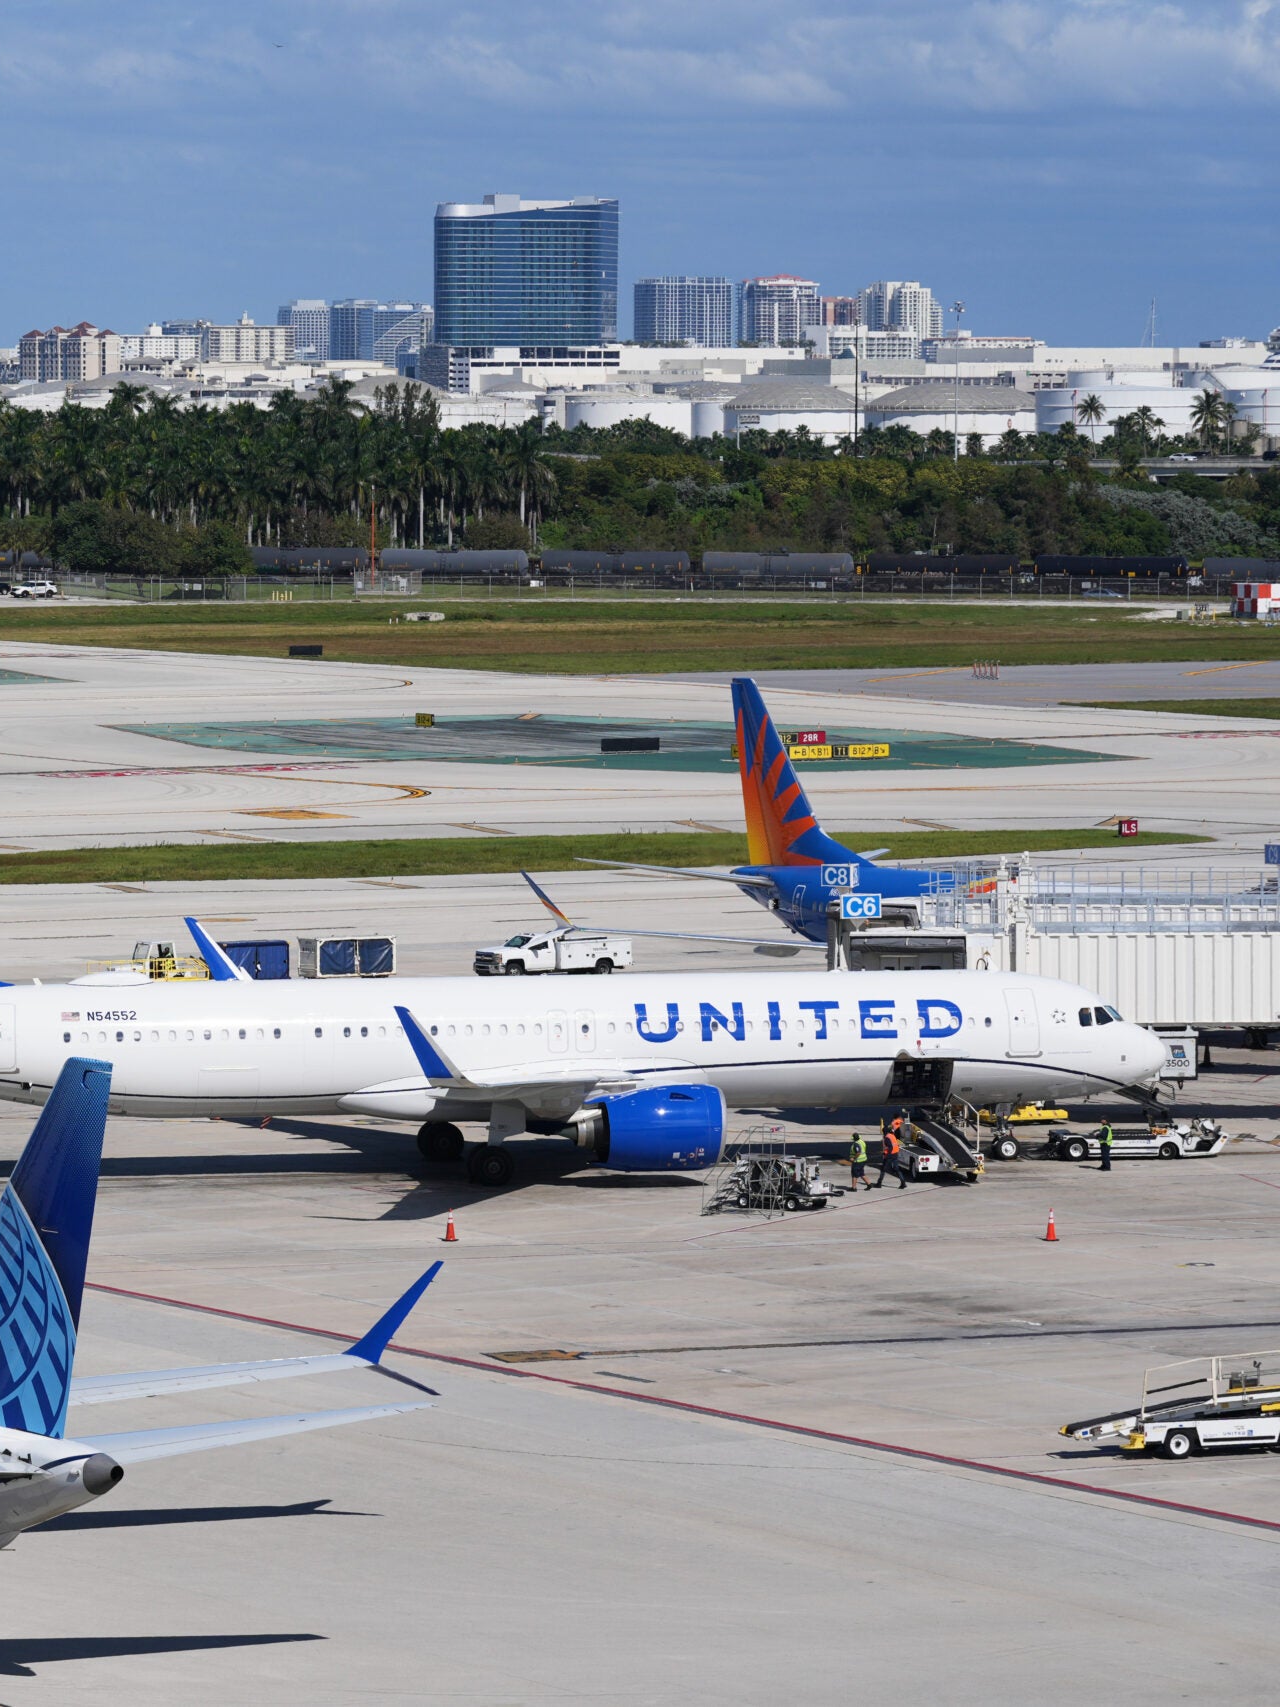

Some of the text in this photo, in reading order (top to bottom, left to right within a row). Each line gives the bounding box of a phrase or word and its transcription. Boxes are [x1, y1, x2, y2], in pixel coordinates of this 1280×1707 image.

[803, 734, 819, 742] 28R
[801, 748, 807, 756] B
[817, 748, 830, 756] B11
[852, 747, 866, 755] B12
[874, 746, 880, 754] B
[1122, 823, 1136, 833] ILS
[824, 867, 847, 885] C8
[846, 897, 876, 917] C6
[87, 1010, 137, 1021] N54552
[634, 999, 963, 1043] UNITED
